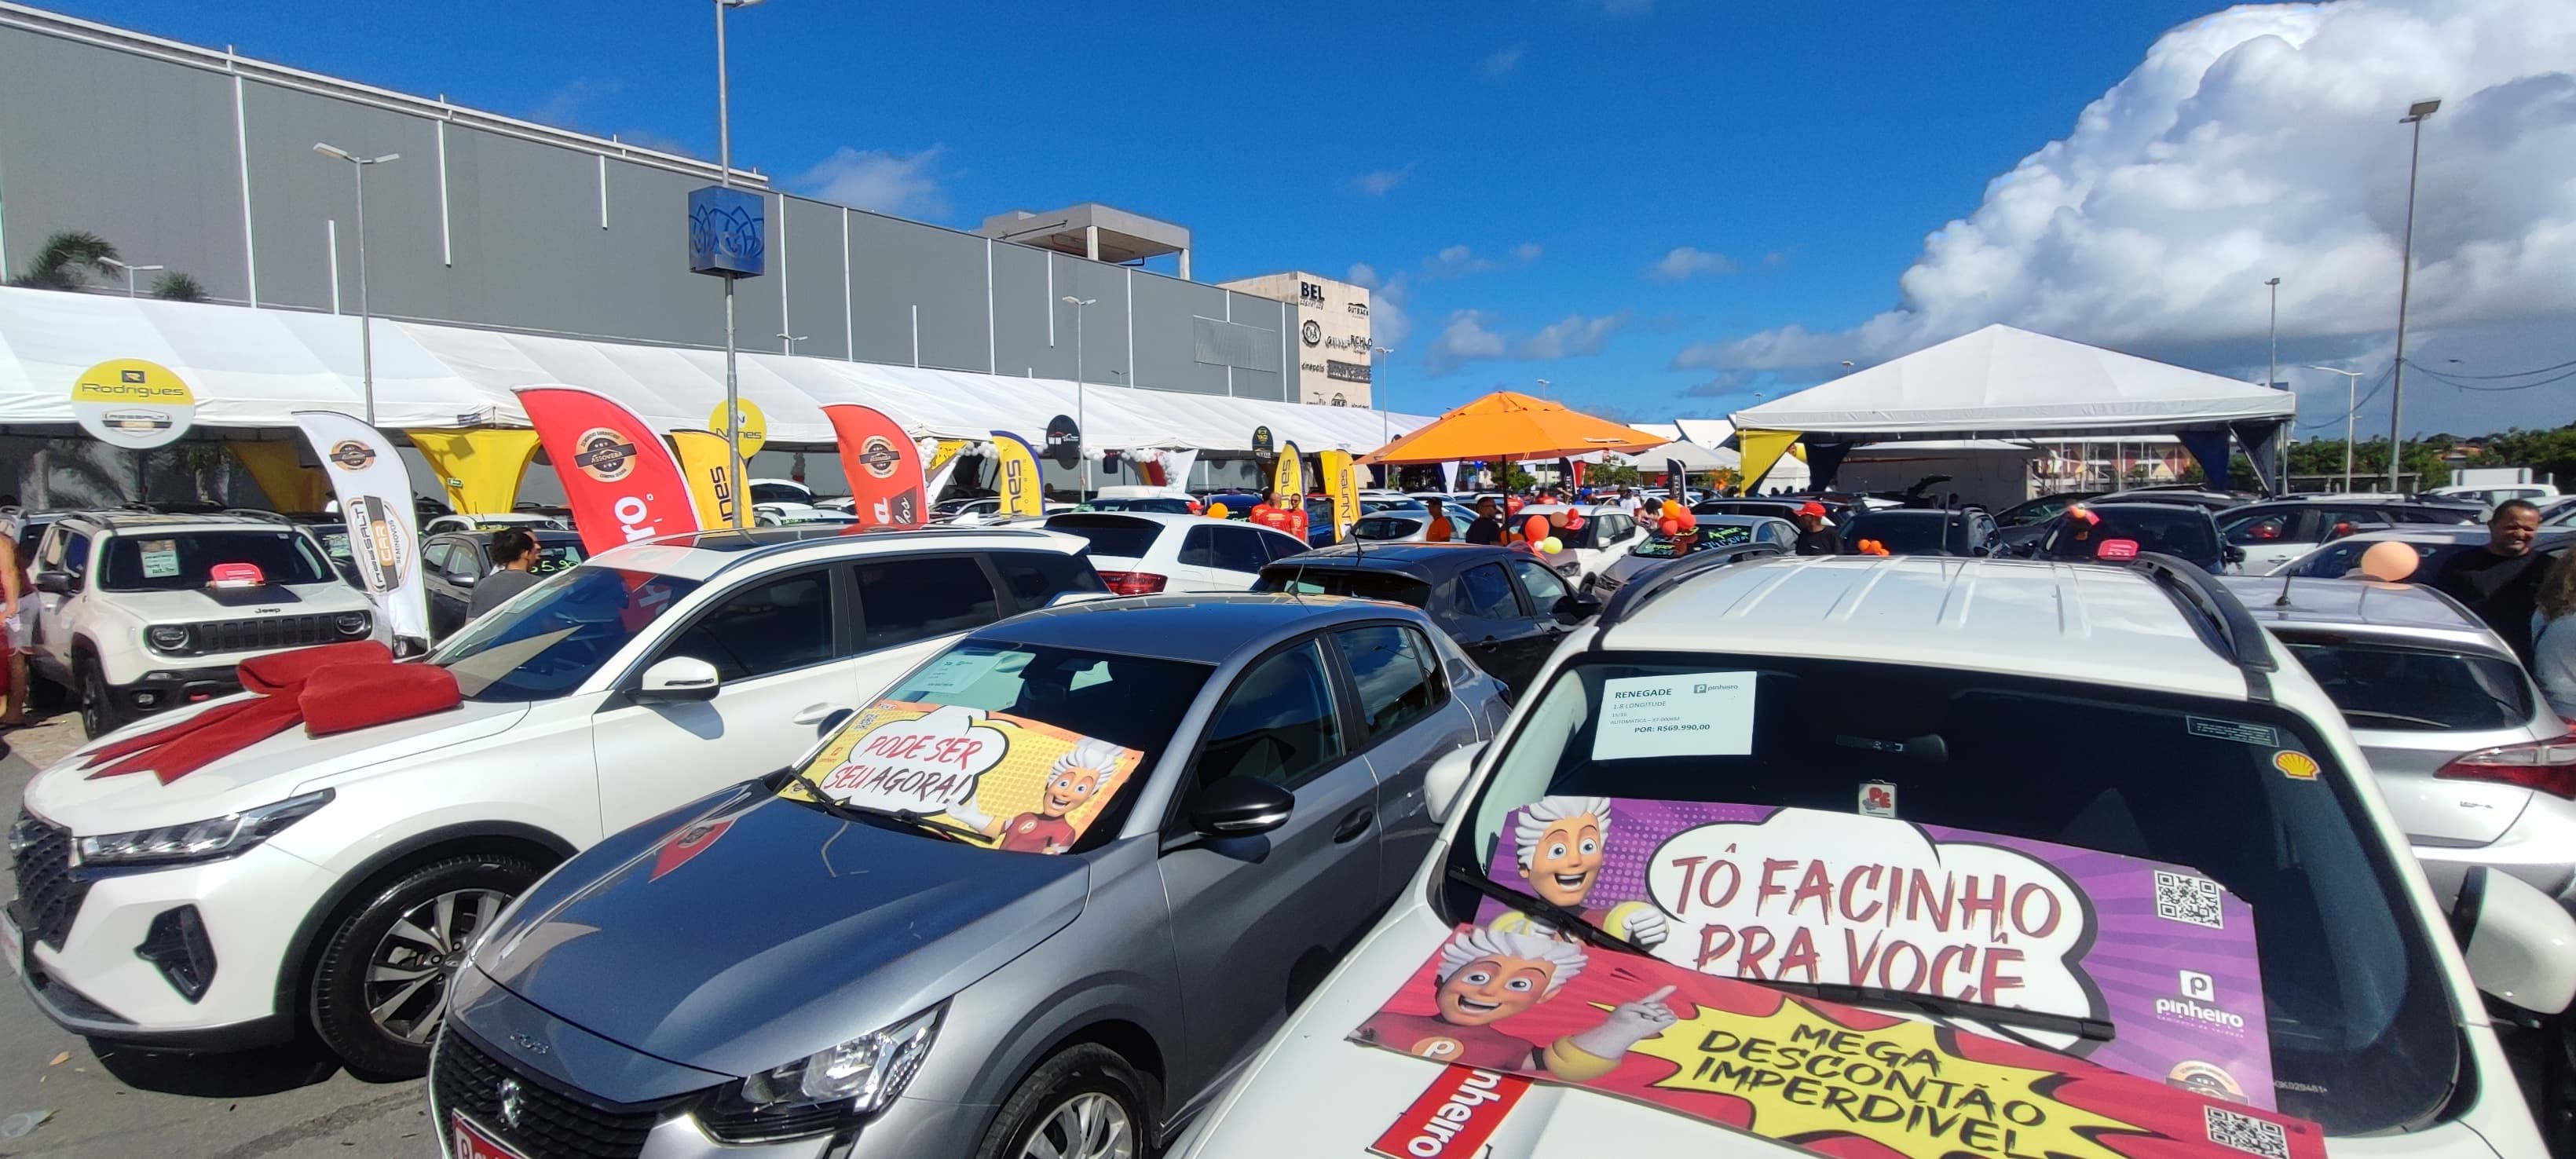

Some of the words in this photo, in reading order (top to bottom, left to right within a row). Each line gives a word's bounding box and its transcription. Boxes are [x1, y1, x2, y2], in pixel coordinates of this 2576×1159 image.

[1301, 281, 1325, 301] BEL
[82, 383, 184, 397] Rodrigues
[716, 427, 762, 439] Nnes
[1007, 459, 1022, 514] nes
[1341, 469, 1351, 518] Nunes
[375, 525, 392, 562] CAR
[389, 520, 401, 564] SEMINOVOS
[1615, 688, 1672, 699] RENEGADE
[1656, 723, 1711, 732] R$69.990,00
[860, 734, 932, 760] PODE
[924, 736, 982, 770] SER
[823, 764, 876, 789] SEU
[862, 766, 973, 803] AGORA!
[1671, 843, 1741, 915] TÔ
[1755, 857, 2062, 941] FACINHO
[1692, 923, 1820, 984] PRA
[1844, 927, 2025, 1008] VOCÊ
[2156, 998, 2244, 1028] pinheiro
[1791, 1023, 1941, 1077] MEGA
[1697, 1029, 2046, 1126] DESCONTÃO
[1407, 1069, 1502, 1157] nheiro
[1692, 1056, 2044, 1159] IMPERDÍVEL
